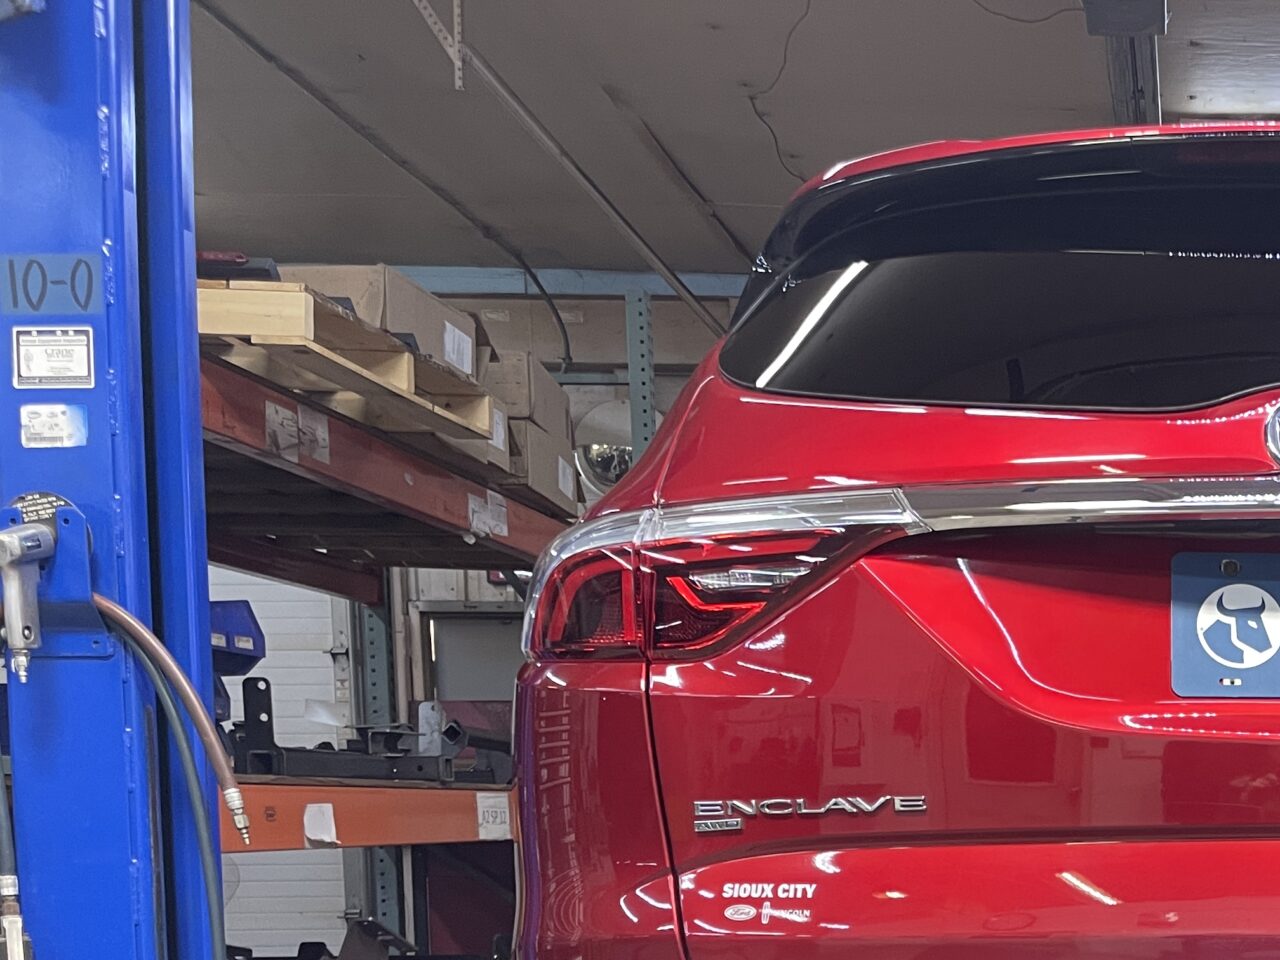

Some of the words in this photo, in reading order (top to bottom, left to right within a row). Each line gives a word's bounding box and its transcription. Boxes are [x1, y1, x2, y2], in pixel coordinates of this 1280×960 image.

[8, 258, 94, 312] 10-0
[693, 795, 927, 816] ENCLAVE
[721, 883, 775, 899] SIOUX
[777, 883, 817, 899] CITY
